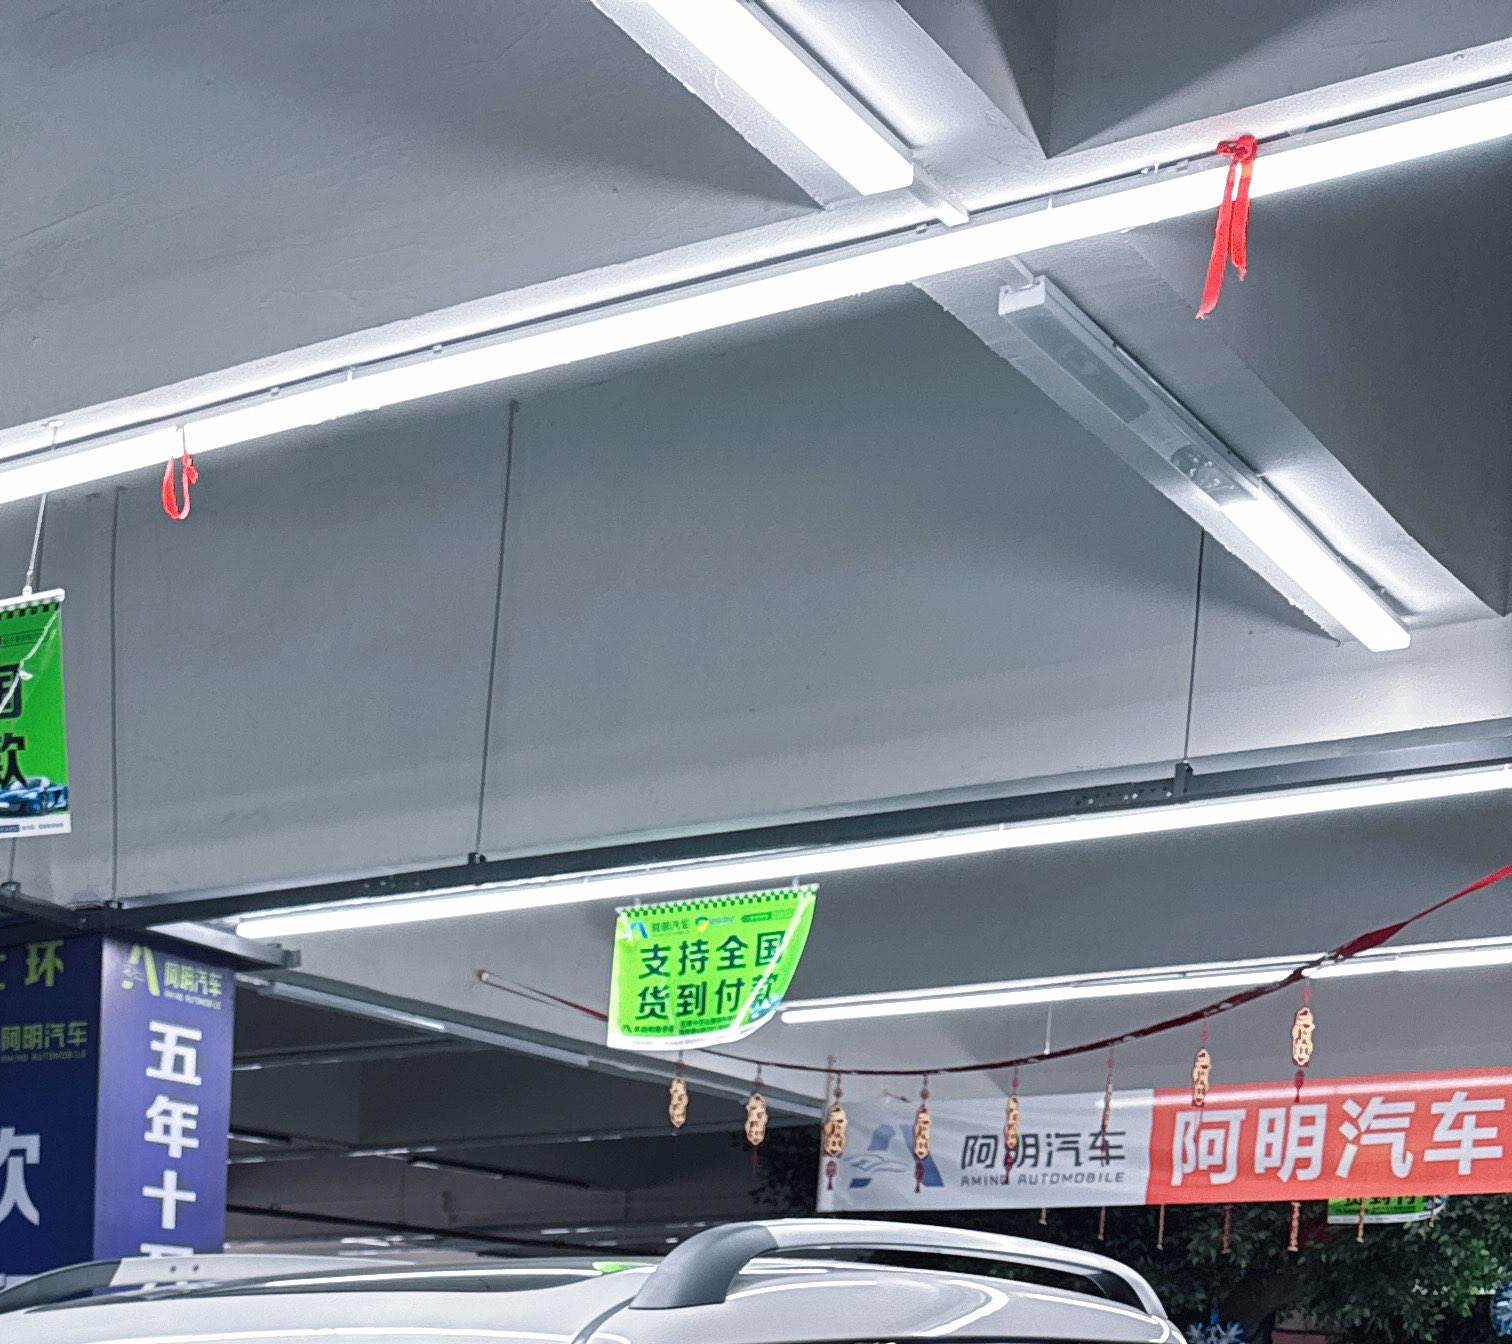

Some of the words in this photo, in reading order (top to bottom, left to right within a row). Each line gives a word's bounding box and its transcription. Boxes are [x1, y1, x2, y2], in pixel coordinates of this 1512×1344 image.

[639, 930, 786, 979] 支持全国
[0, 1020, 88, 1051] 阿明汽车
[961, 1131, 1126, 1169] 阿明汽车
[1170, 1091, 1506, 1187] 阿明汽车
[1017, 1172, 1125, 1186] AUTOMOBILE
